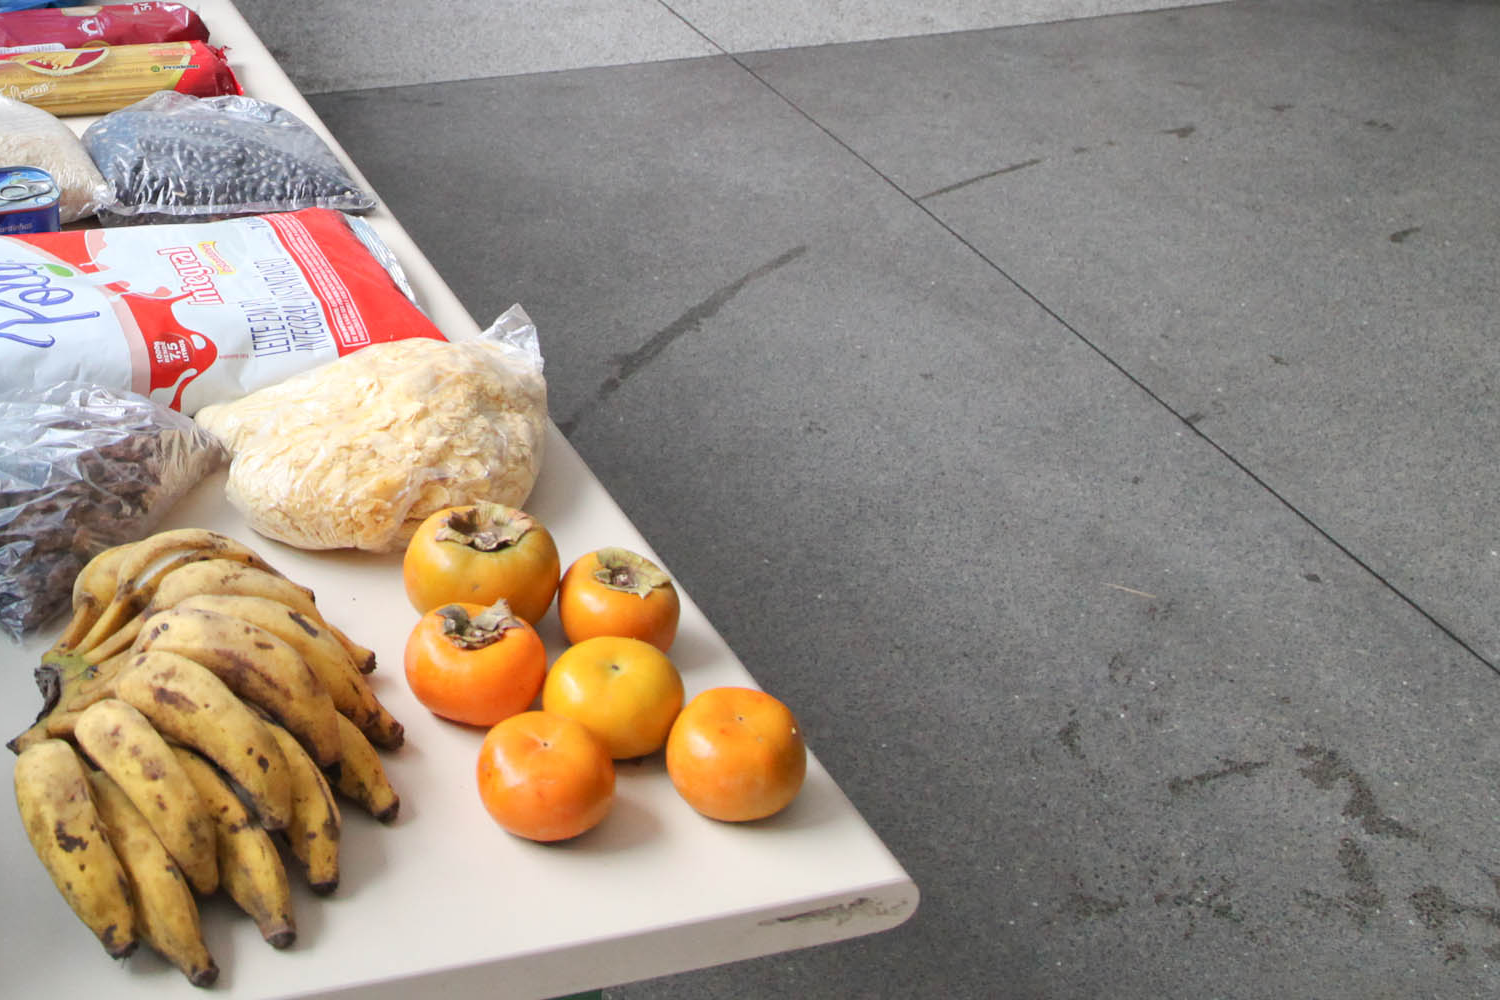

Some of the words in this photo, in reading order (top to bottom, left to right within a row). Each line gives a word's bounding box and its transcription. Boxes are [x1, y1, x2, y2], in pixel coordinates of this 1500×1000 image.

[157, 246, 225, 305] Integral
[250, 325, 291, 358] LEITE
[282, 301, 331, 351] INTEGRAL
[167, 342, 181, 362] 7,5
[178, 339, 190, 362] LITROS
